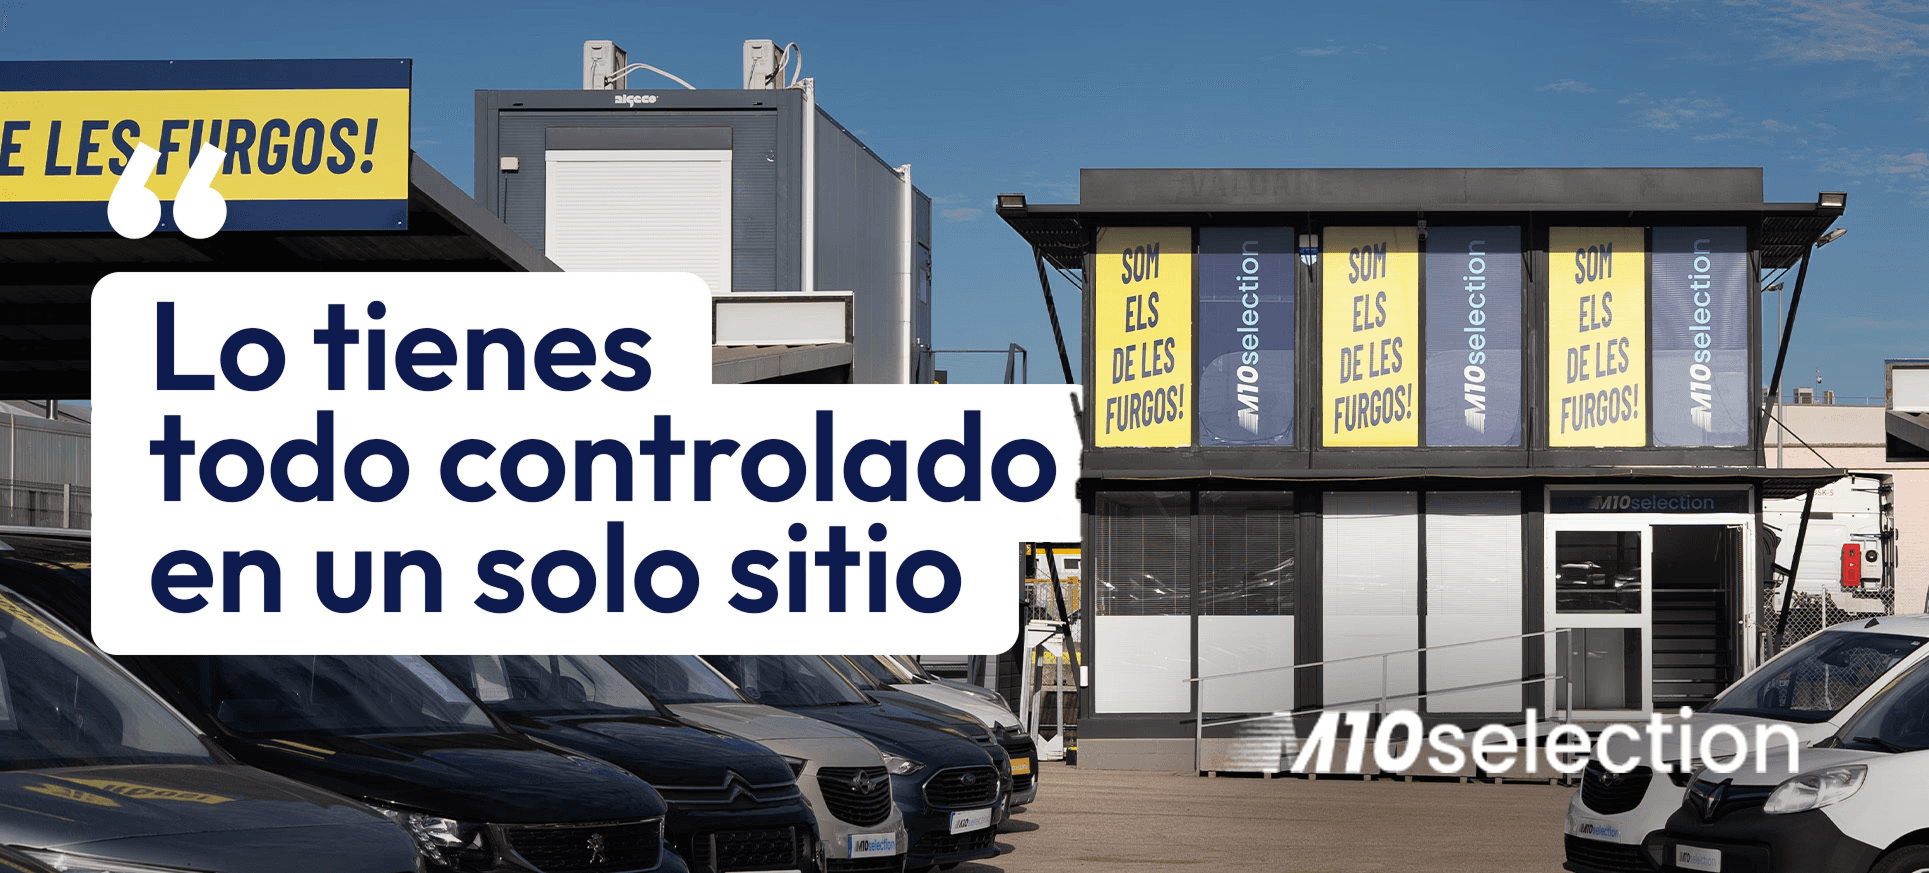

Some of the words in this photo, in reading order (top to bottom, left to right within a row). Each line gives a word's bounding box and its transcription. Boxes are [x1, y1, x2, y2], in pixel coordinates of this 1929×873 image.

[614, 94, 657, 108] algeco
[44, 119, 141, 176] LES
[1122, 242, 1159, 284] SOM
[1349, 242, 1386, 284] SOM
[1575, 242, 1612, 284] SOM
[1125, 291, 1159, 332] ELS
[1352, 291, 1386, 332] ELS
[1579, 291, 1612, 332] ELS
[1112, 344, 1136, 384] DE
[1142, 337, 1175, 378] LES
[1340, 344, 1364, 384] DE
[1369, 337, 1403, 378] LES
[1567, 344, 1590, 384] DE
[1596, 337, 1629, 378] LES
[1106, 384, 1184, 434] FURGOS!
[1334, 383, 1412, 434] FURGOS!
[1561, 384, 1638, 434] FURGOS!
